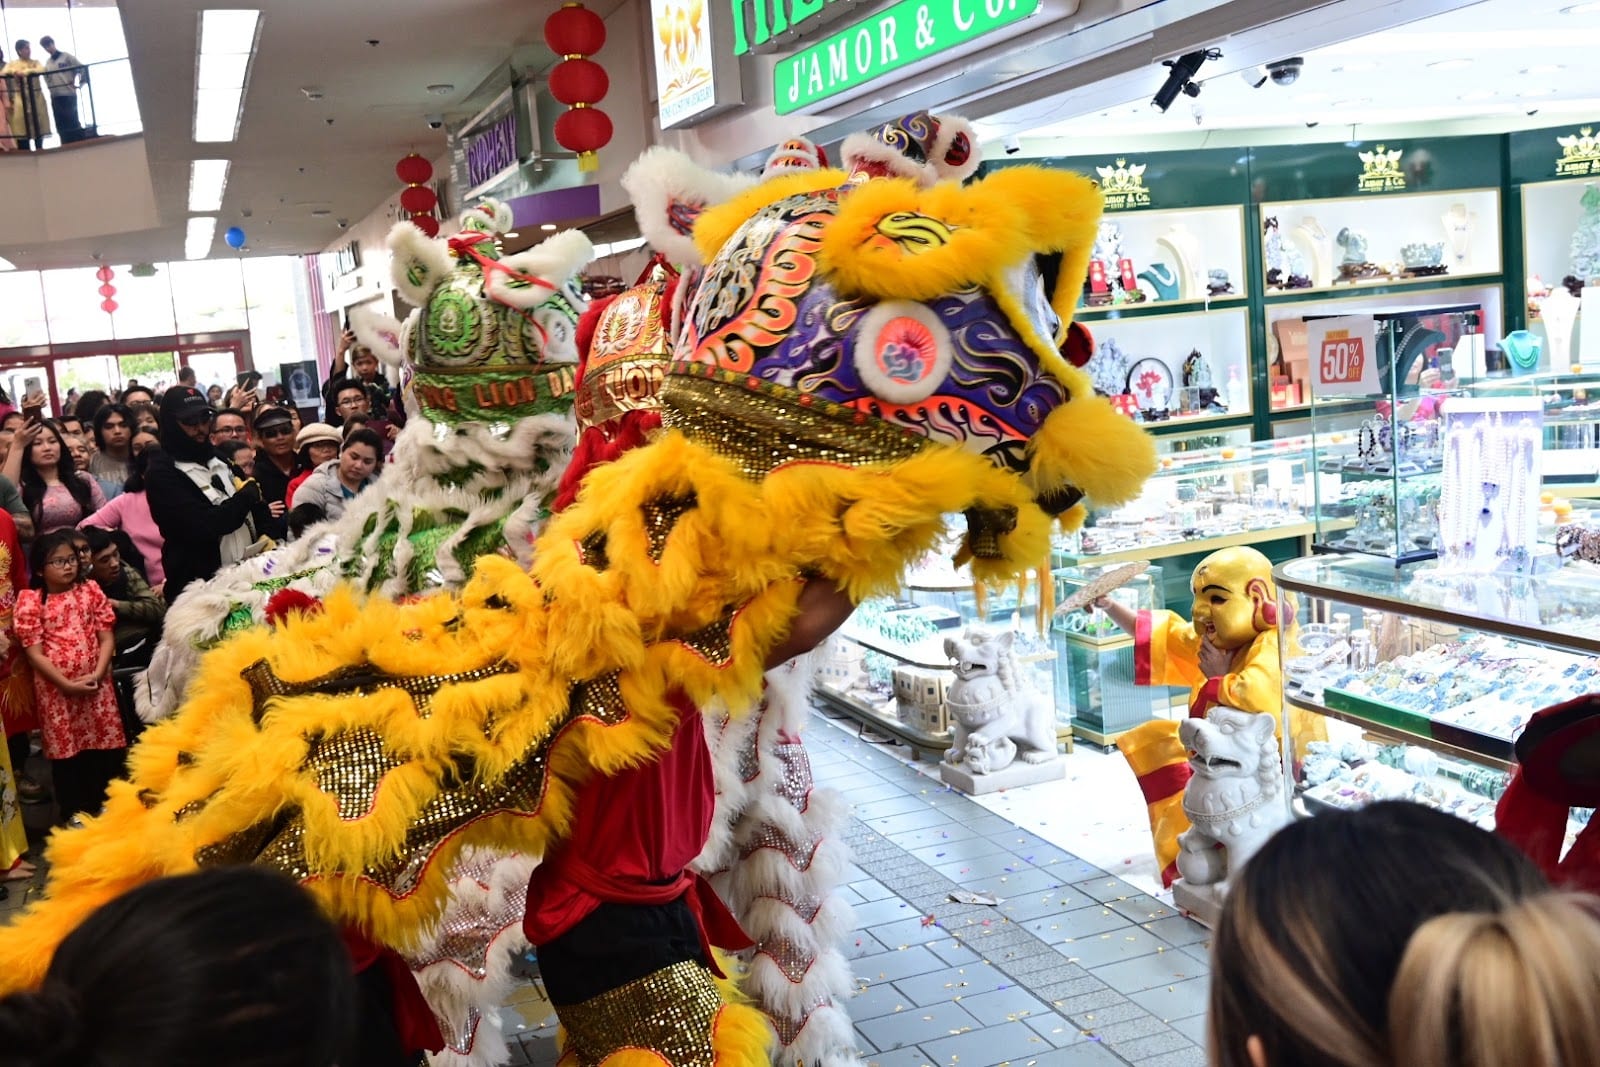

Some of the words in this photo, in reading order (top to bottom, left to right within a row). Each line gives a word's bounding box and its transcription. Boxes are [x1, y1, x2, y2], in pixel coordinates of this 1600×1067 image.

[788, 16, 898, 103] J'AMOR
[915, 4, 935, 50] &
[1136, 192, 1151, 202] Co.
[1323, 343, 1360, 380] 50%
[1348, 366, 1360, 378] OFF
[475, 377, 536, 408] LION
[549, 365, 577, 398] DA
